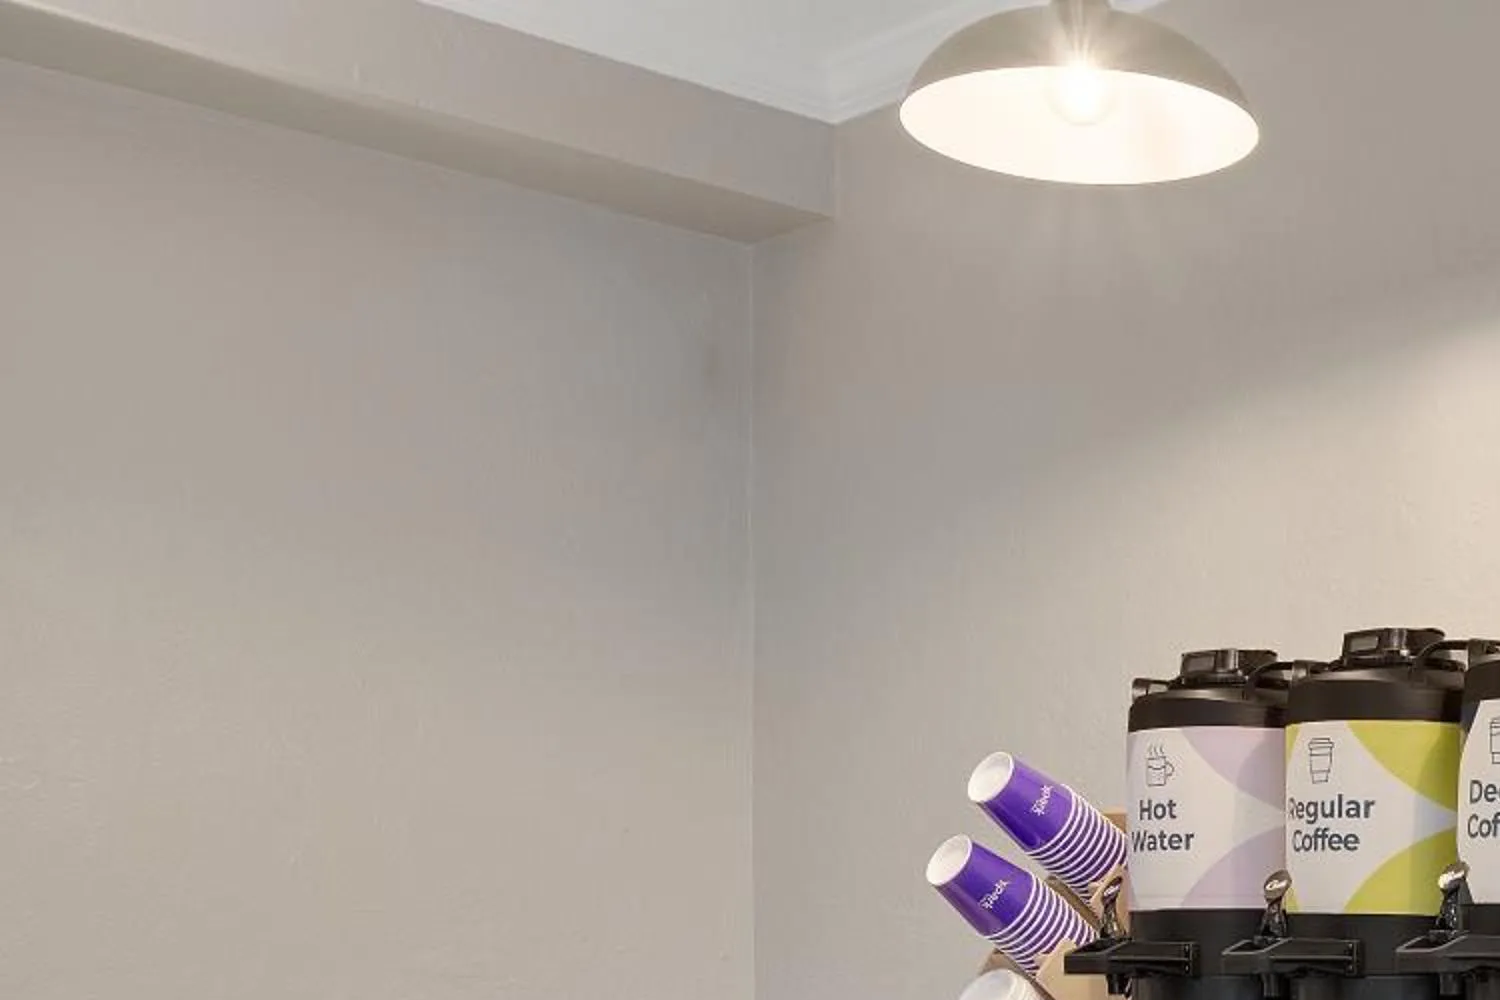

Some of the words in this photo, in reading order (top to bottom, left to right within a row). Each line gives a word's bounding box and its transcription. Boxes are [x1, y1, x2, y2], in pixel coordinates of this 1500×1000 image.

[1139, 799, 1177, 820] Hot
[1288, 793, 1376, 825] Regular
[1131, 830, 1195, 852] Water
[1292, 827, 1361, 852] Coffee
